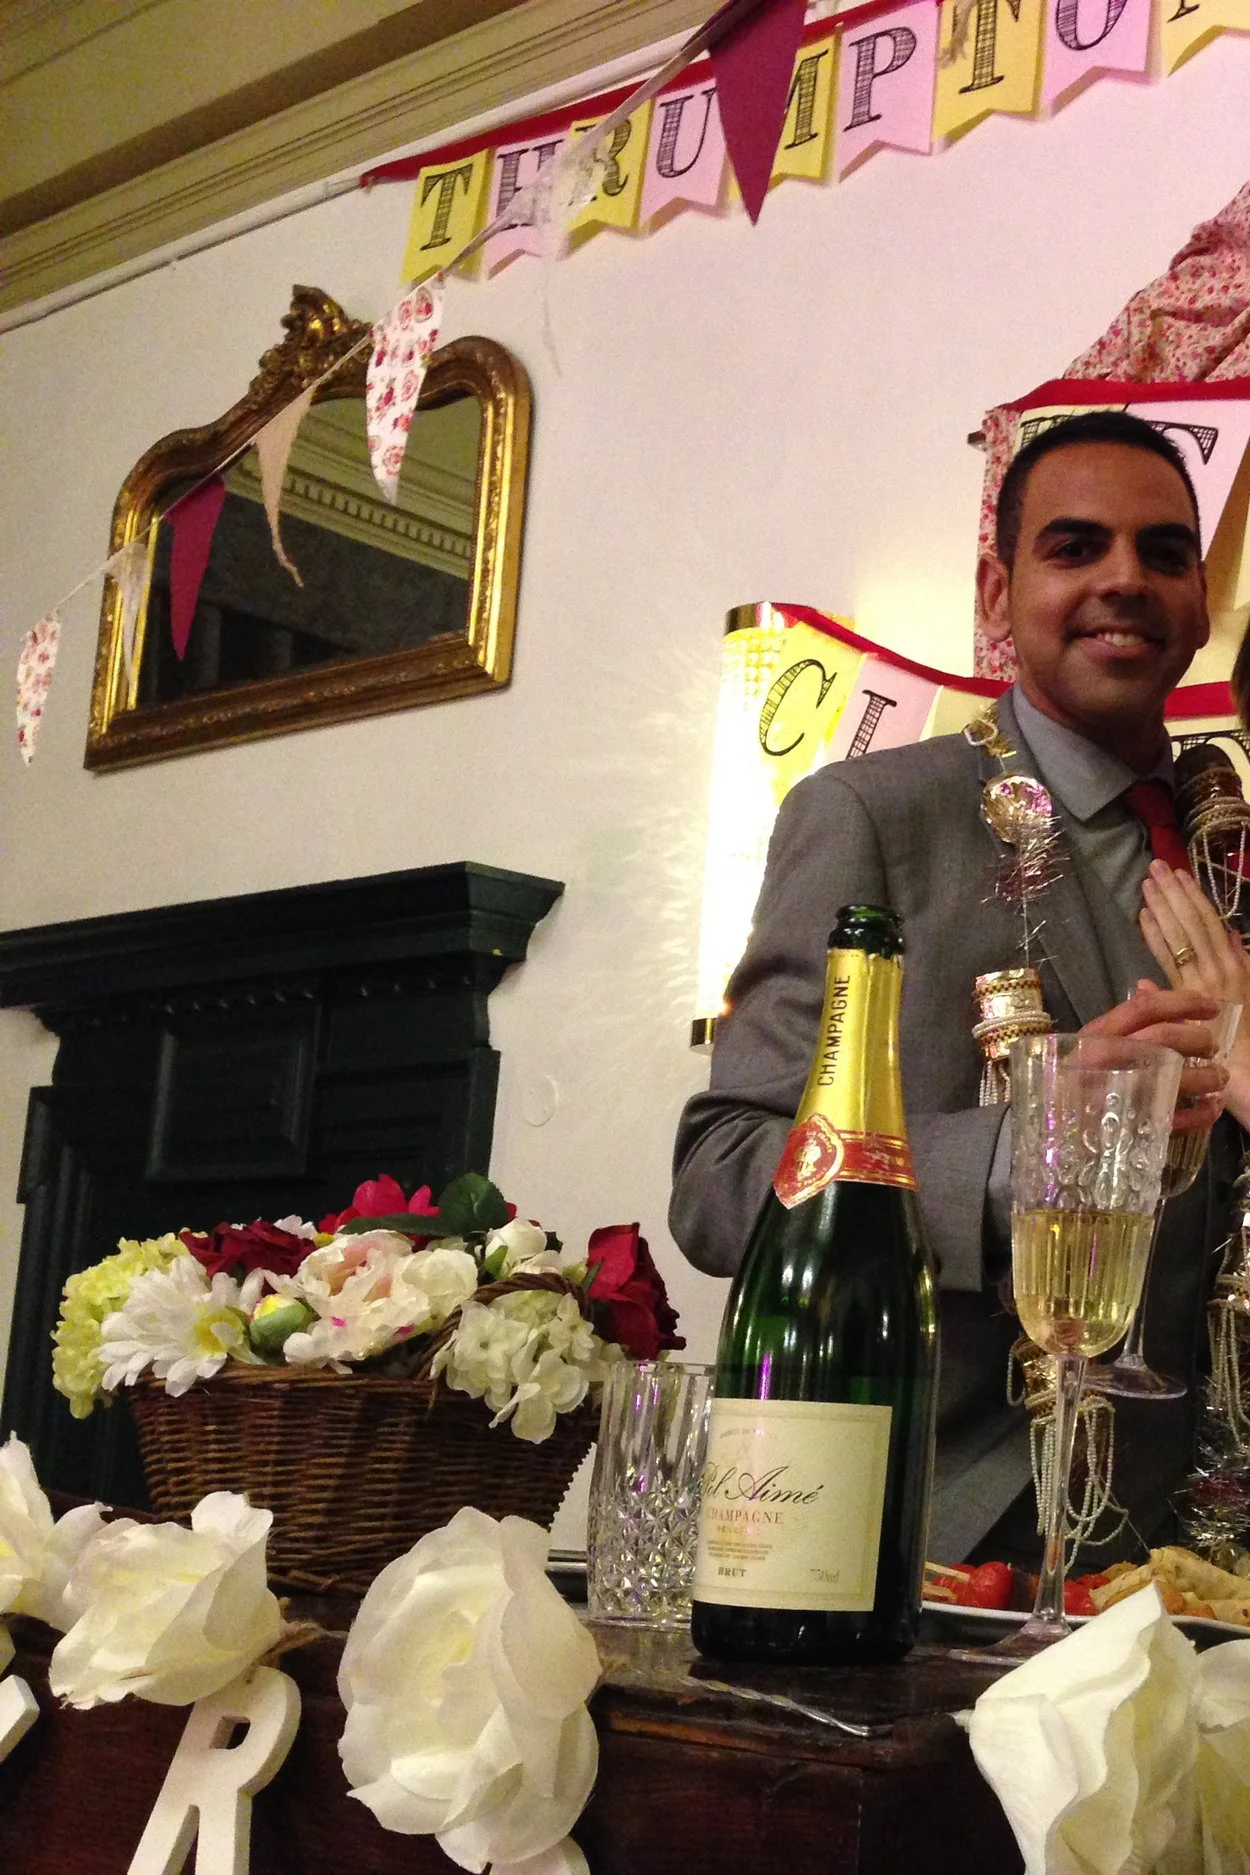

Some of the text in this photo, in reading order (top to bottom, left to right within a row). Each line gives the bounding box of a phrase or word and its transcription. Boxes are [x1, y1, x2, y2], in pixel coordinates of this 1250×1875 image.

[420, 0, 1200, 251] THRUPT
[818, 976, 851, 1086] CHAMPAGNE
[724, 1465, 824, 1505] Aimé
[706, 1506, 785, 1525] CHAMPAGNE
[717, 1566, 747, 1578] BRUT
